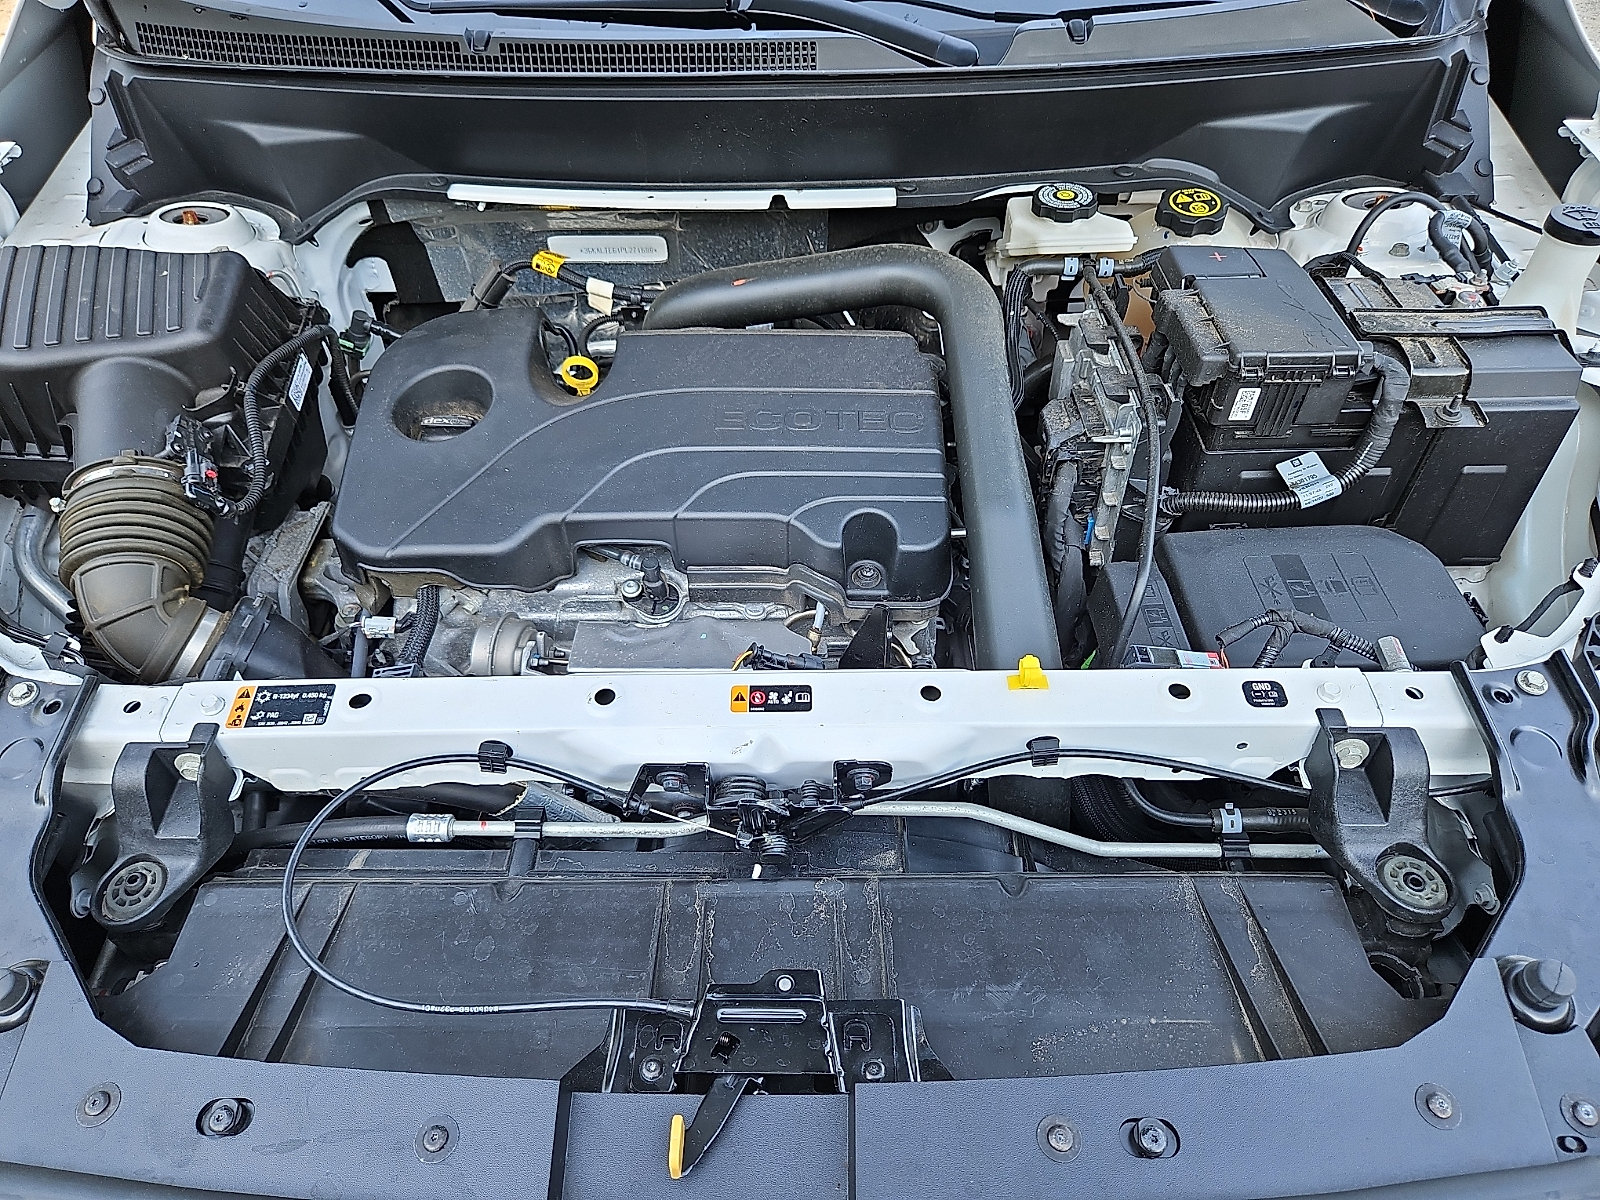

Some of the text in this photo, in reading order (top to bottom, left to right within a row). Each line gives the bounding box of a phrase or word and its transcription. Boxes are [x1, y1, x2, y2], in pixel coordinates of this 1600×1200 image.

[713, 409, 925, 434] ECOTEC
[1251, 682, 1272, 690] GND
[266, 711, 279, 719] PAG
